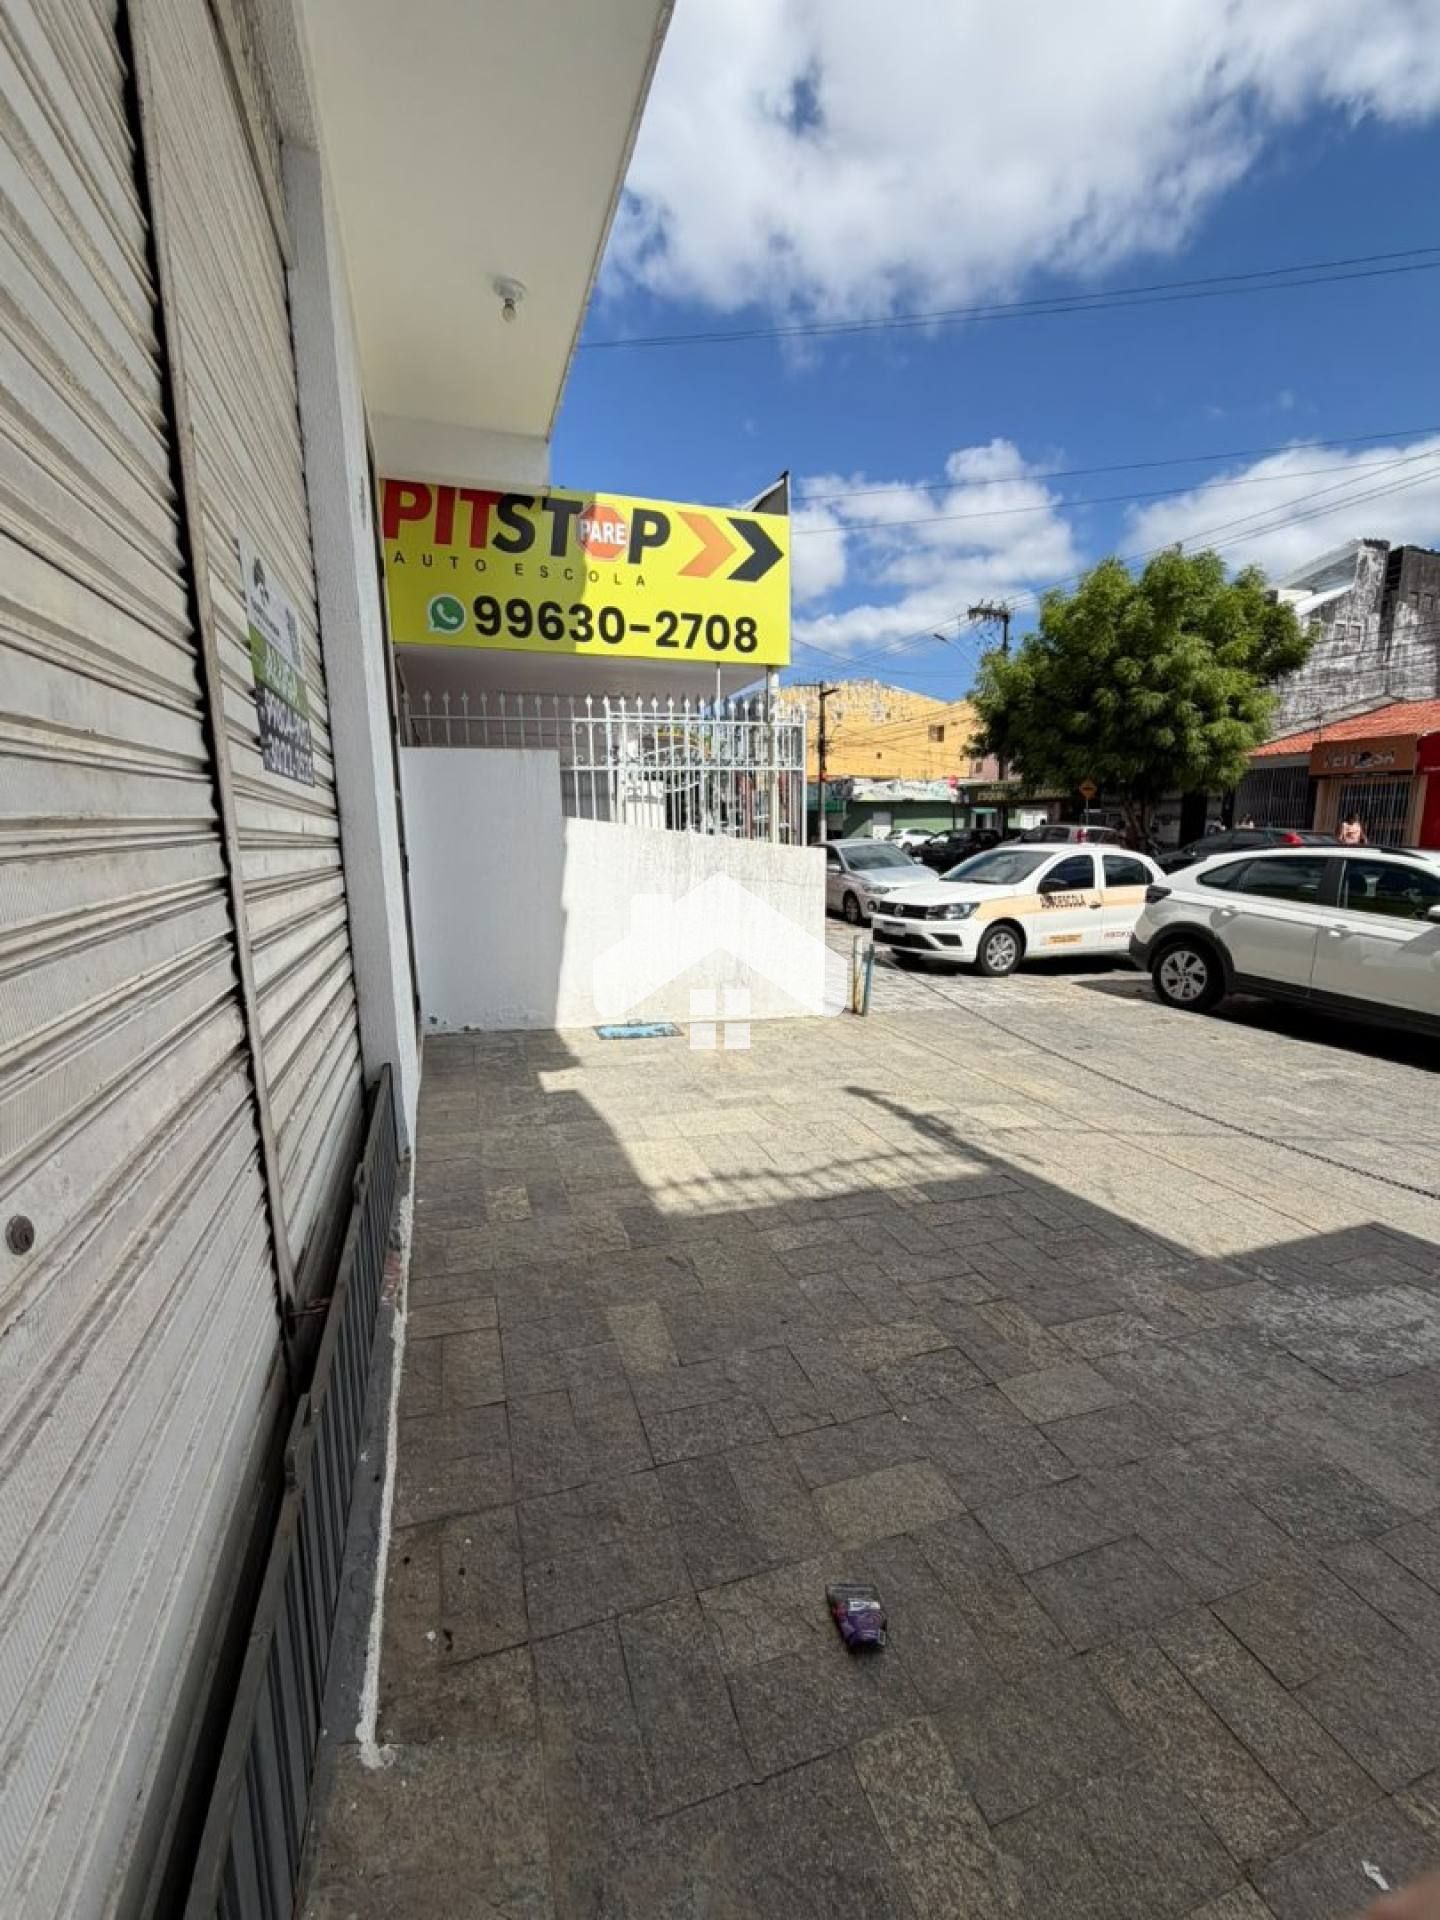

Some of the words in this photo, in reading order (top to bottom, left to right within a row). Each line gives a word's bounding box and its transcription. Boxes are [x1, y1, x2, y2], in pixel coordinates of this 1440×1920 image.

[580, 520, 627, 545] PARE
[393, 551, 487, 572] AUTO
[514, 562, 646, 587] ESCOLA
[472, 595, 759, 654] 99630-2708
